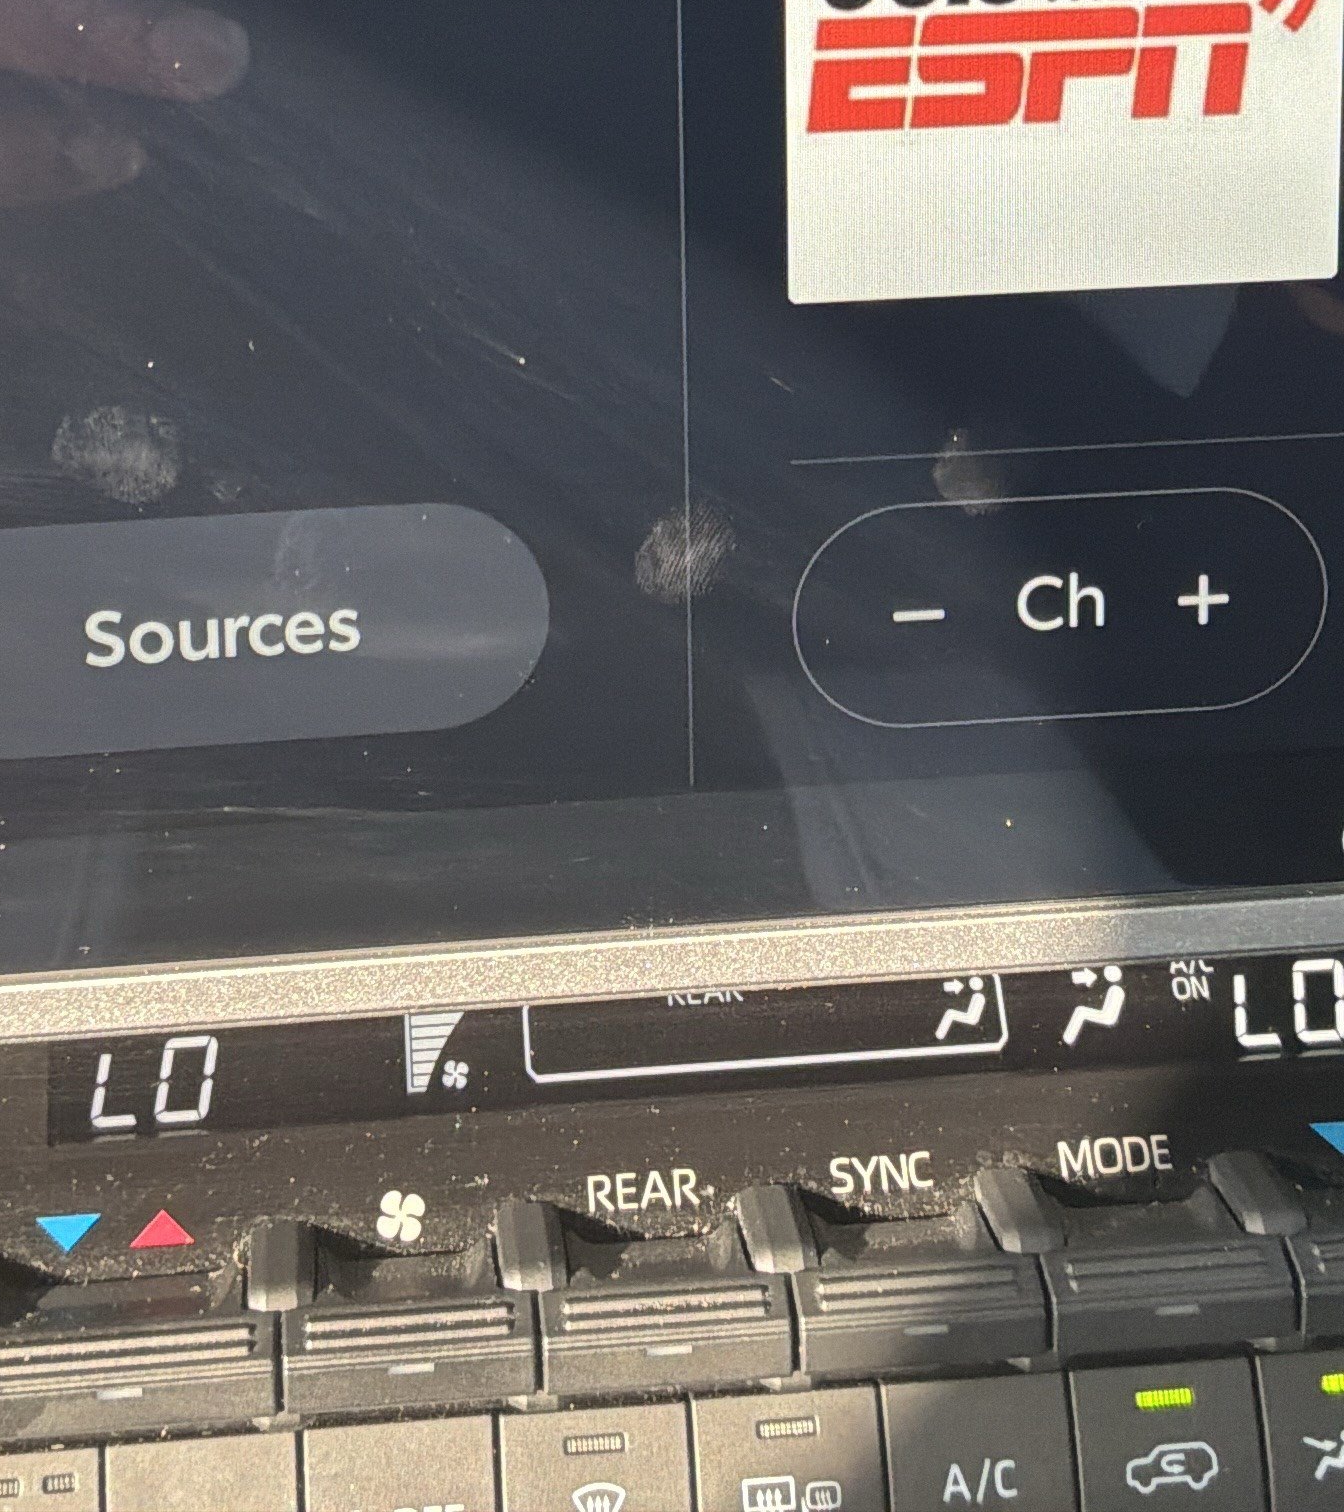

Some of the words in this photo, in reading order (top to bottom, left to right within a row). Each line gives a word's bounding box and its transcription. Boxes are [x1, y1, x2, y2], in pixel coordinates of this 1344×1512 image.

[807, 3, 1253, 134] ESPN
[1016, 571, 1105, 631] Ch
[85, 608, 362, 668] Sources
[1170, 974, 1211, 1002] ON
[828, 1150, 934, 1196] SYNC
[1057, 1133, 1174, 1181] MODE
[585, 1168, 699, 1216] REAR
[942, 1457, 1018, 1504] A/C
